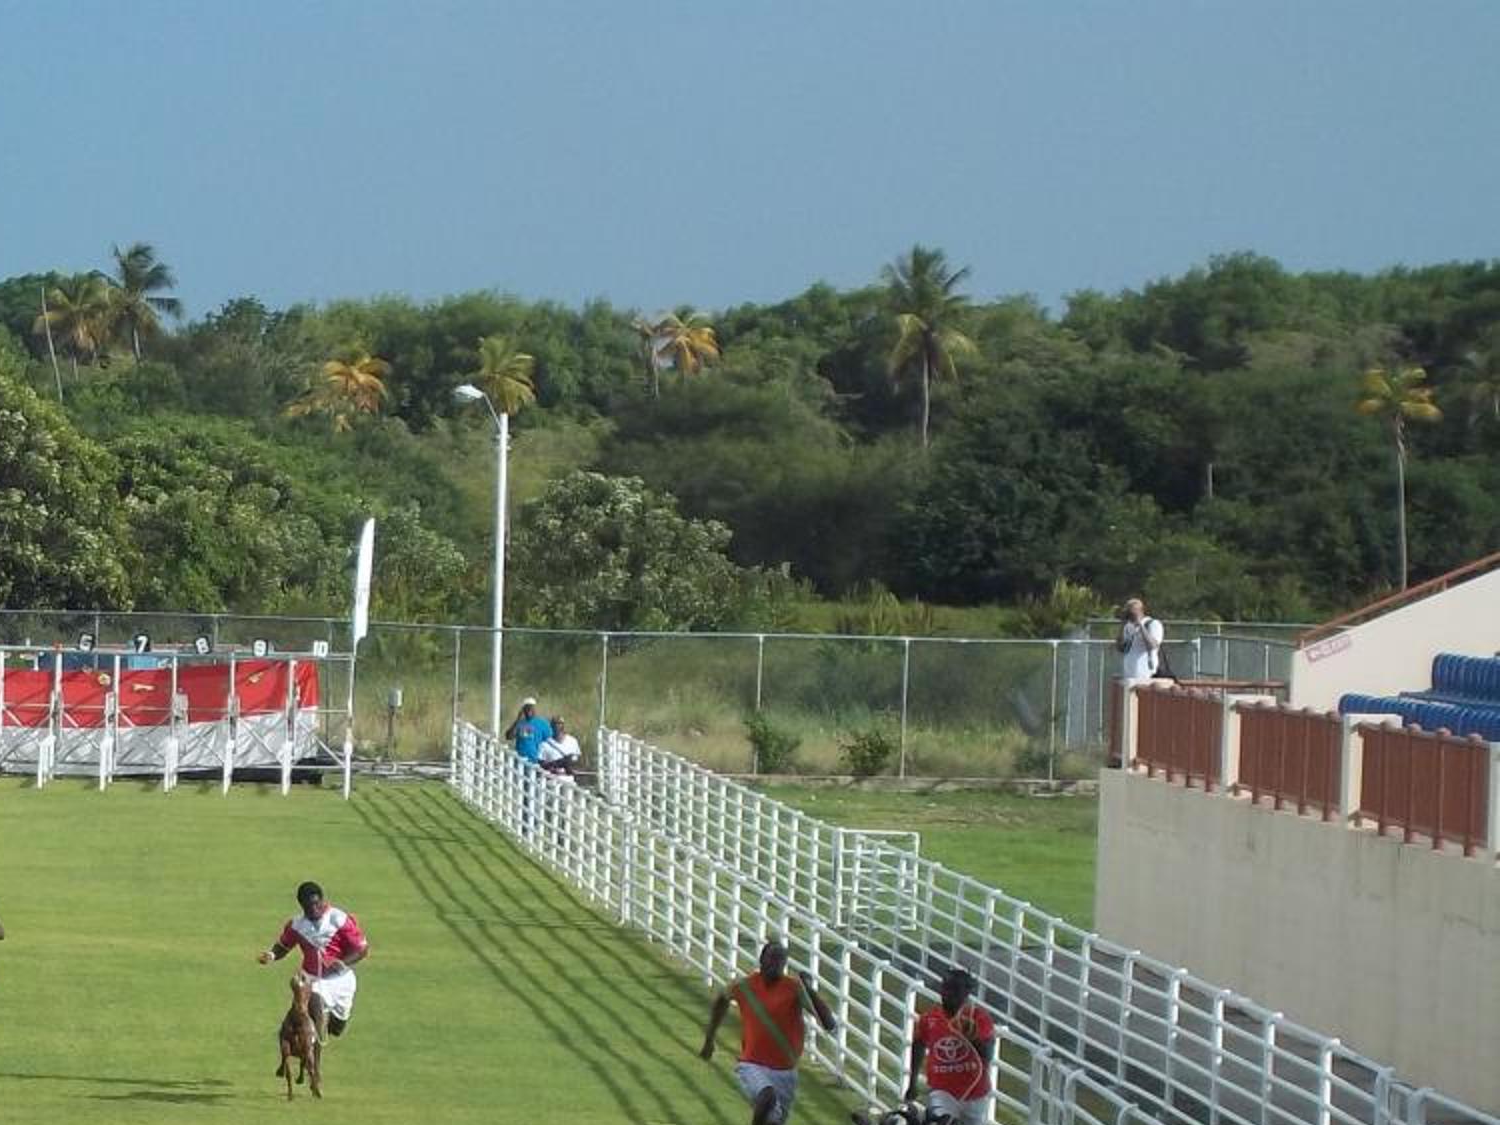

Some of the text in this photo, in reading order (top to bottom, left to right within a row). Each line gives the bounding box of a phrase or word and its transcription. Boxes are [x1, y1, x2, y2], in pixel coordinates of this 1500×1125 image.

[80, 634, 93, 652] 6
[137, 636, 149, 653] 7
[196, 637, 210, 654] 8
[313, 640, 329, 657] 10
[932, 1061, 978, 1074] TOYOTA
